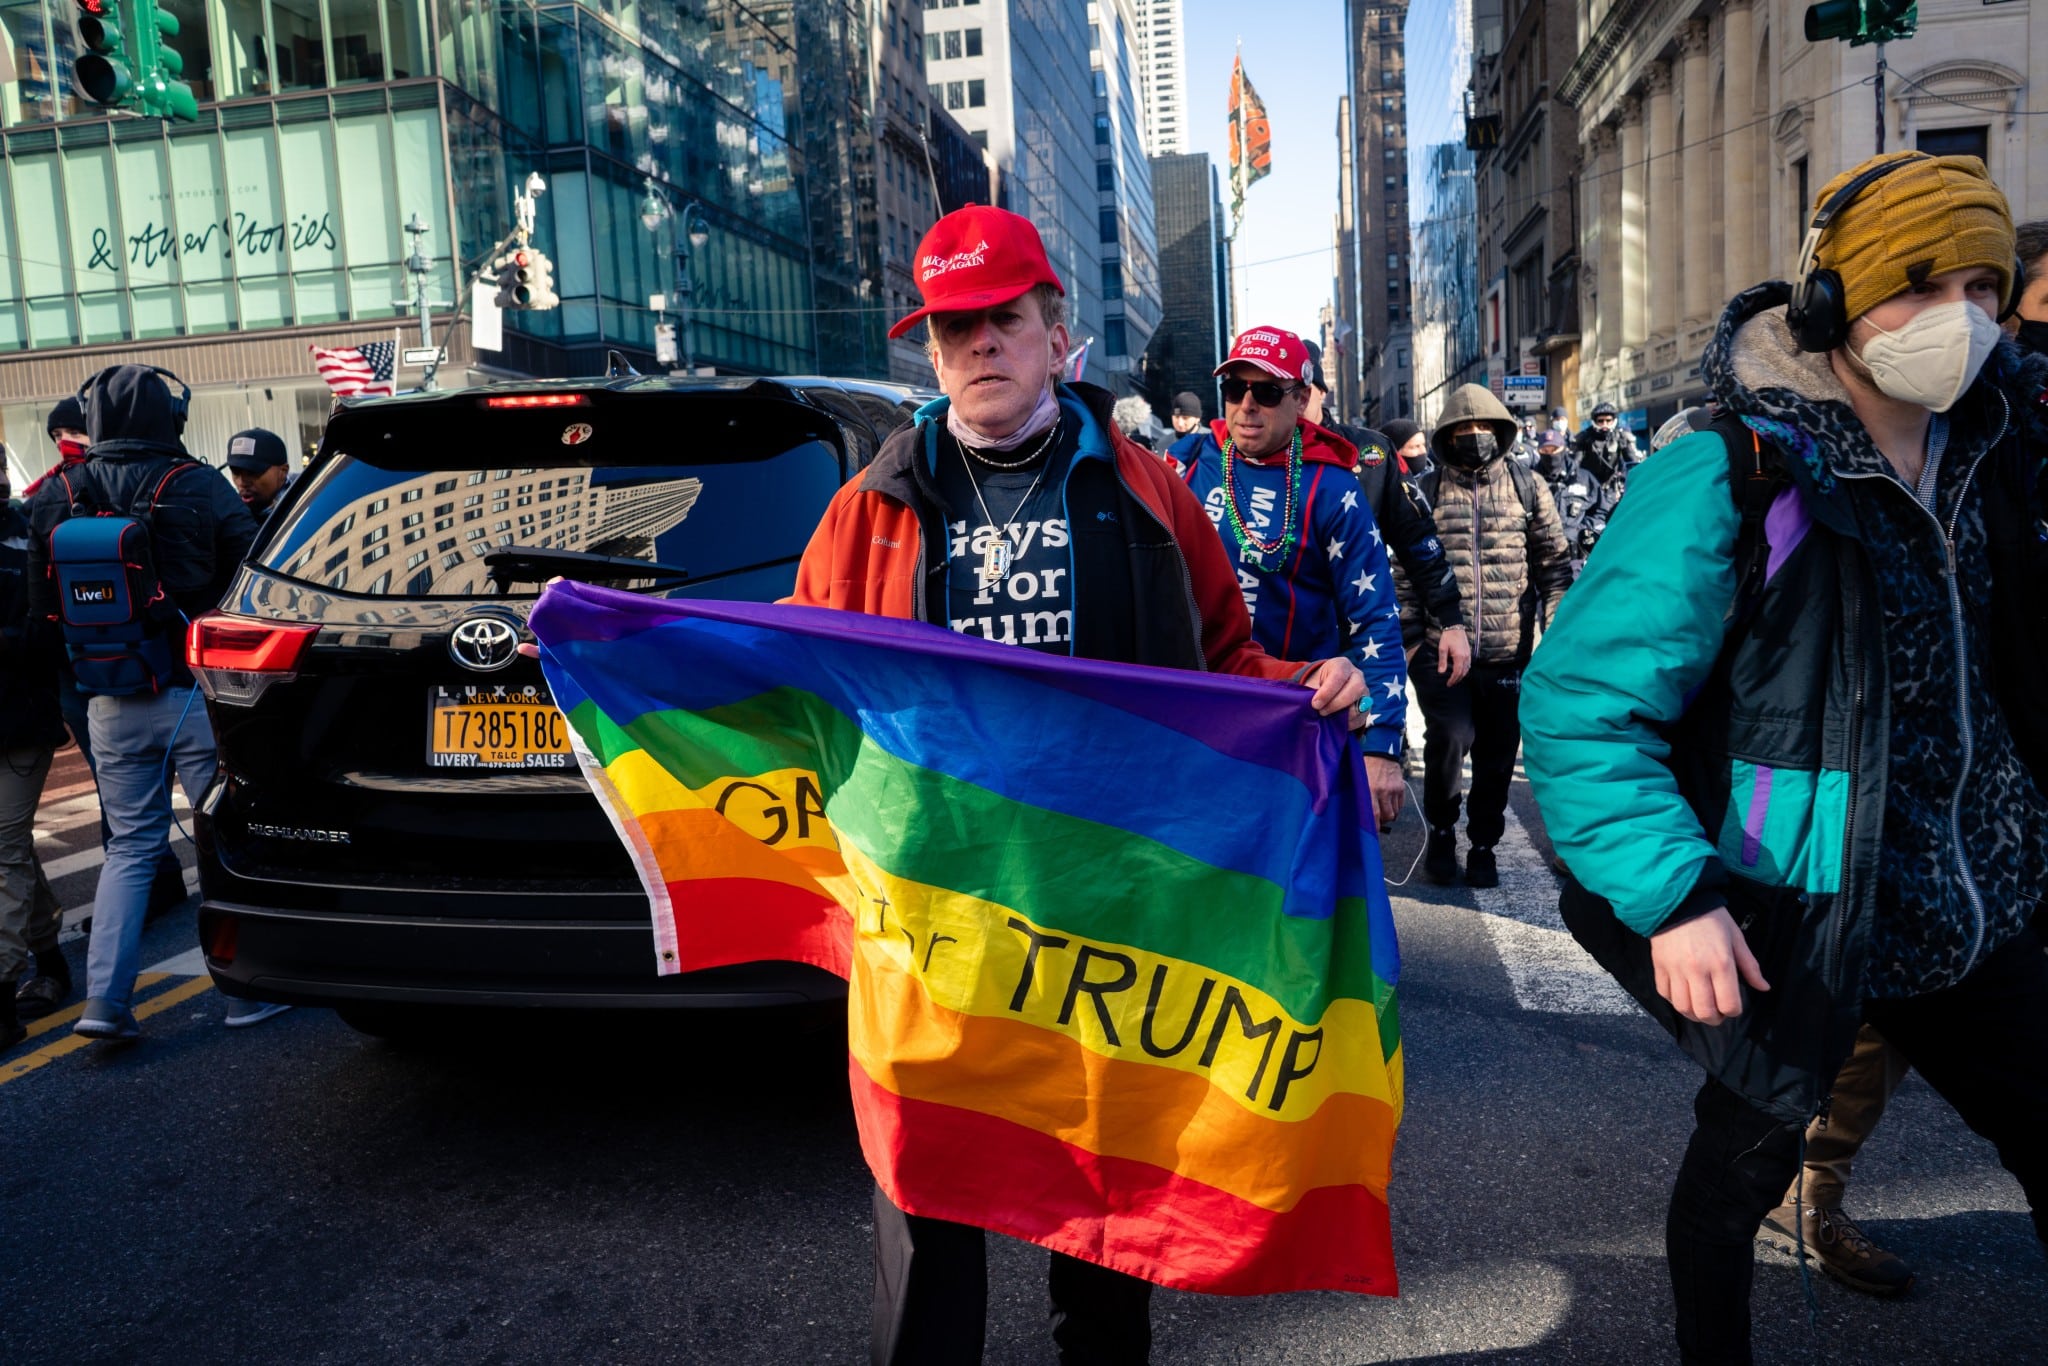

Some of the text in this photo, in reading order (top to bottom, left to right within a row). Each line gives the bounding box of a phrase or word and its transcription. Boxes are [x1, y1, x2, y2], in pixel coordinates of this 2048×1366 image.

[88, 228, 119, 271] &
[223, 212, 336, 259] Stories
[922, 240, 990, 269] MAKE AMERICA
[949, 254, 985, 271] AGAIN
[1240, 346, 1269, 357] 2020
[949, 519, 1069, 560] Gays
[74, 586, 113, 601] LiveU
[973, 568, 1066, 605] For
[467, 692, 541, 704] NEW YORK
[442, 711, 562, 748] T738518C
[434, 753, 478, 767] LIVERY
[526, 754, 565, 767] SALES
[491, 751, 518, 760] T&LC
[247, 822, 352, 844] HIGHLANDER
[1008, 919, 1324, 1112] TRUMP
